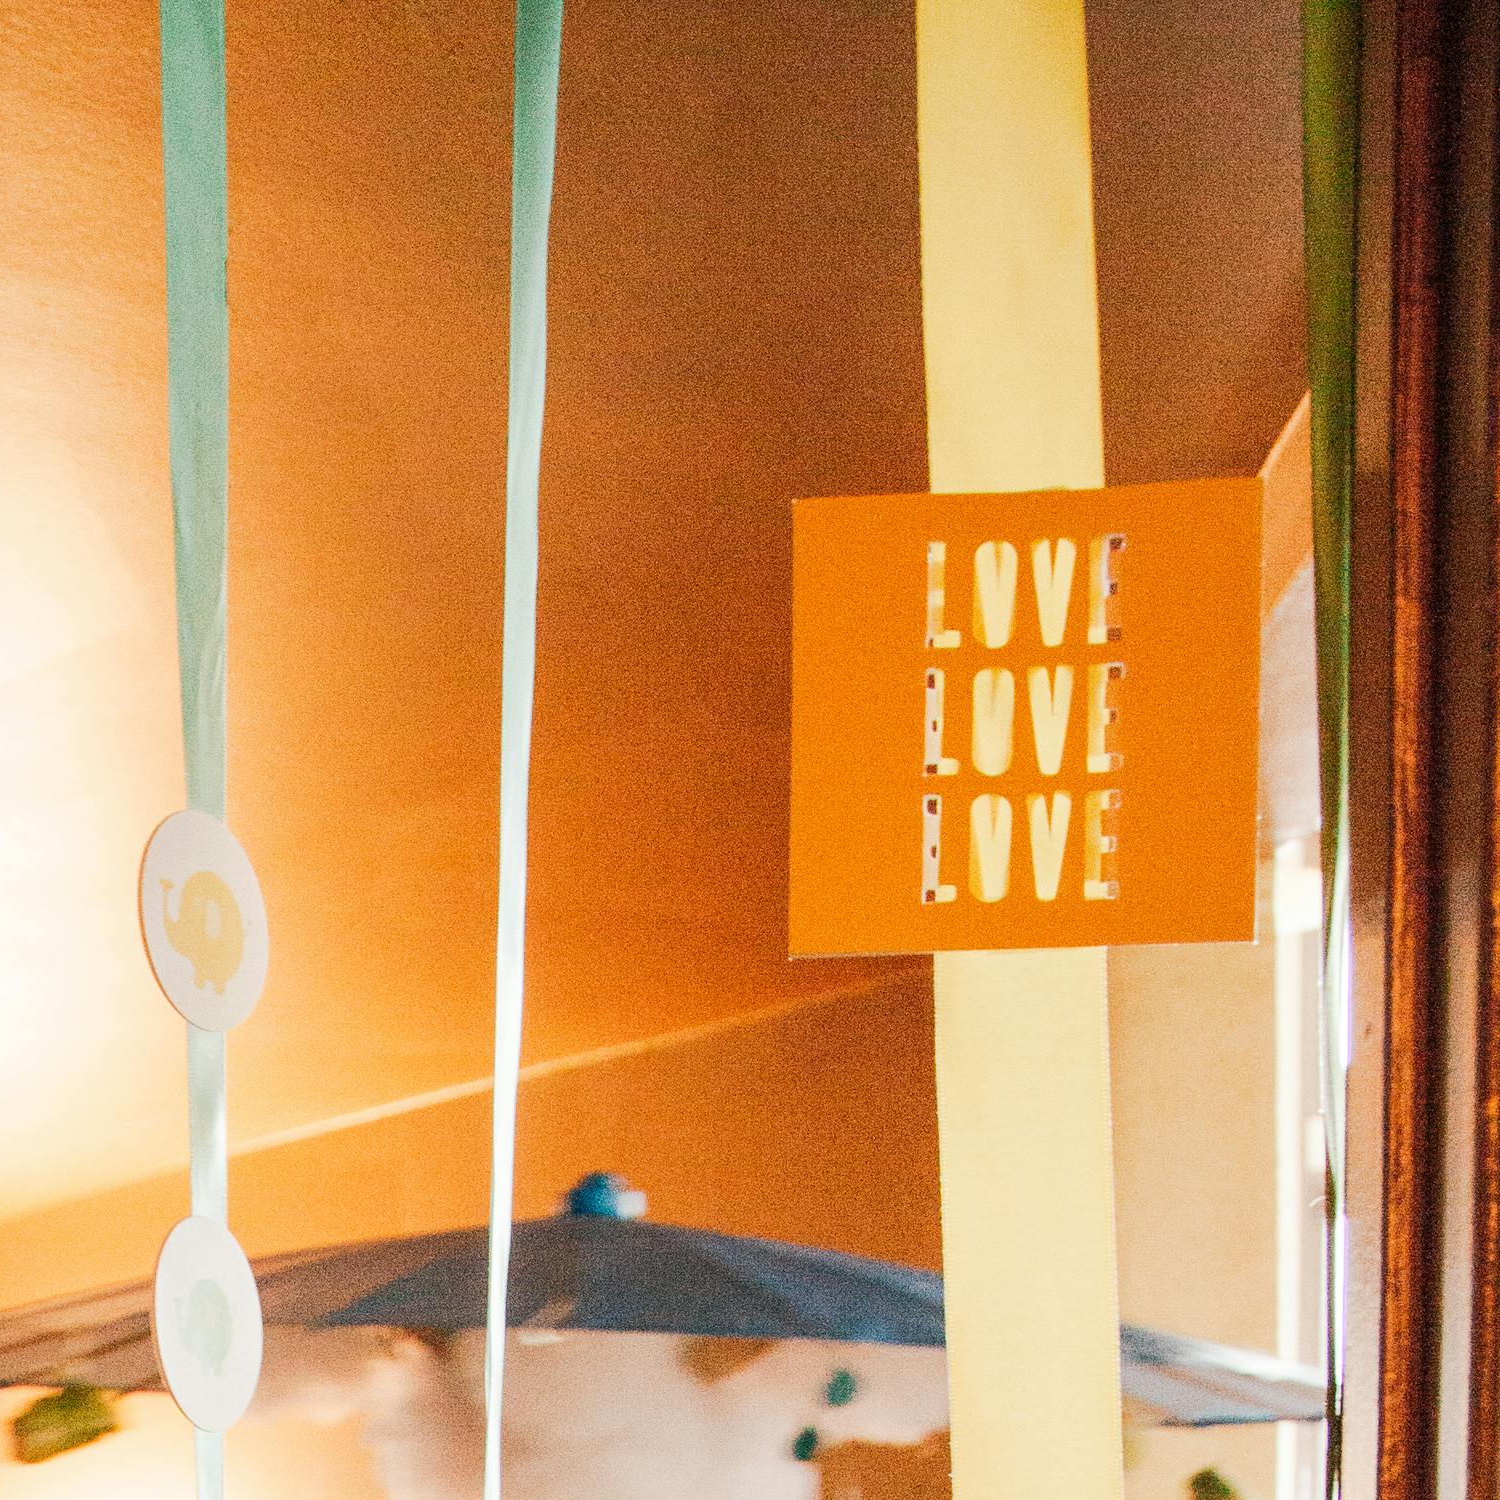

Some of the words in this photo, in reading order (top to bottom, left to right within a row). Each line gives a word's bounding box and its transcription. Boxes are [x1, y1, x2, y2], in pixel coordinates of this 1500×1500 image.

[926, 532, 1127, 648] LOVE
[922, 661, 1126, 777] LOVE
[920, 789, 1123, 904] LOVE
